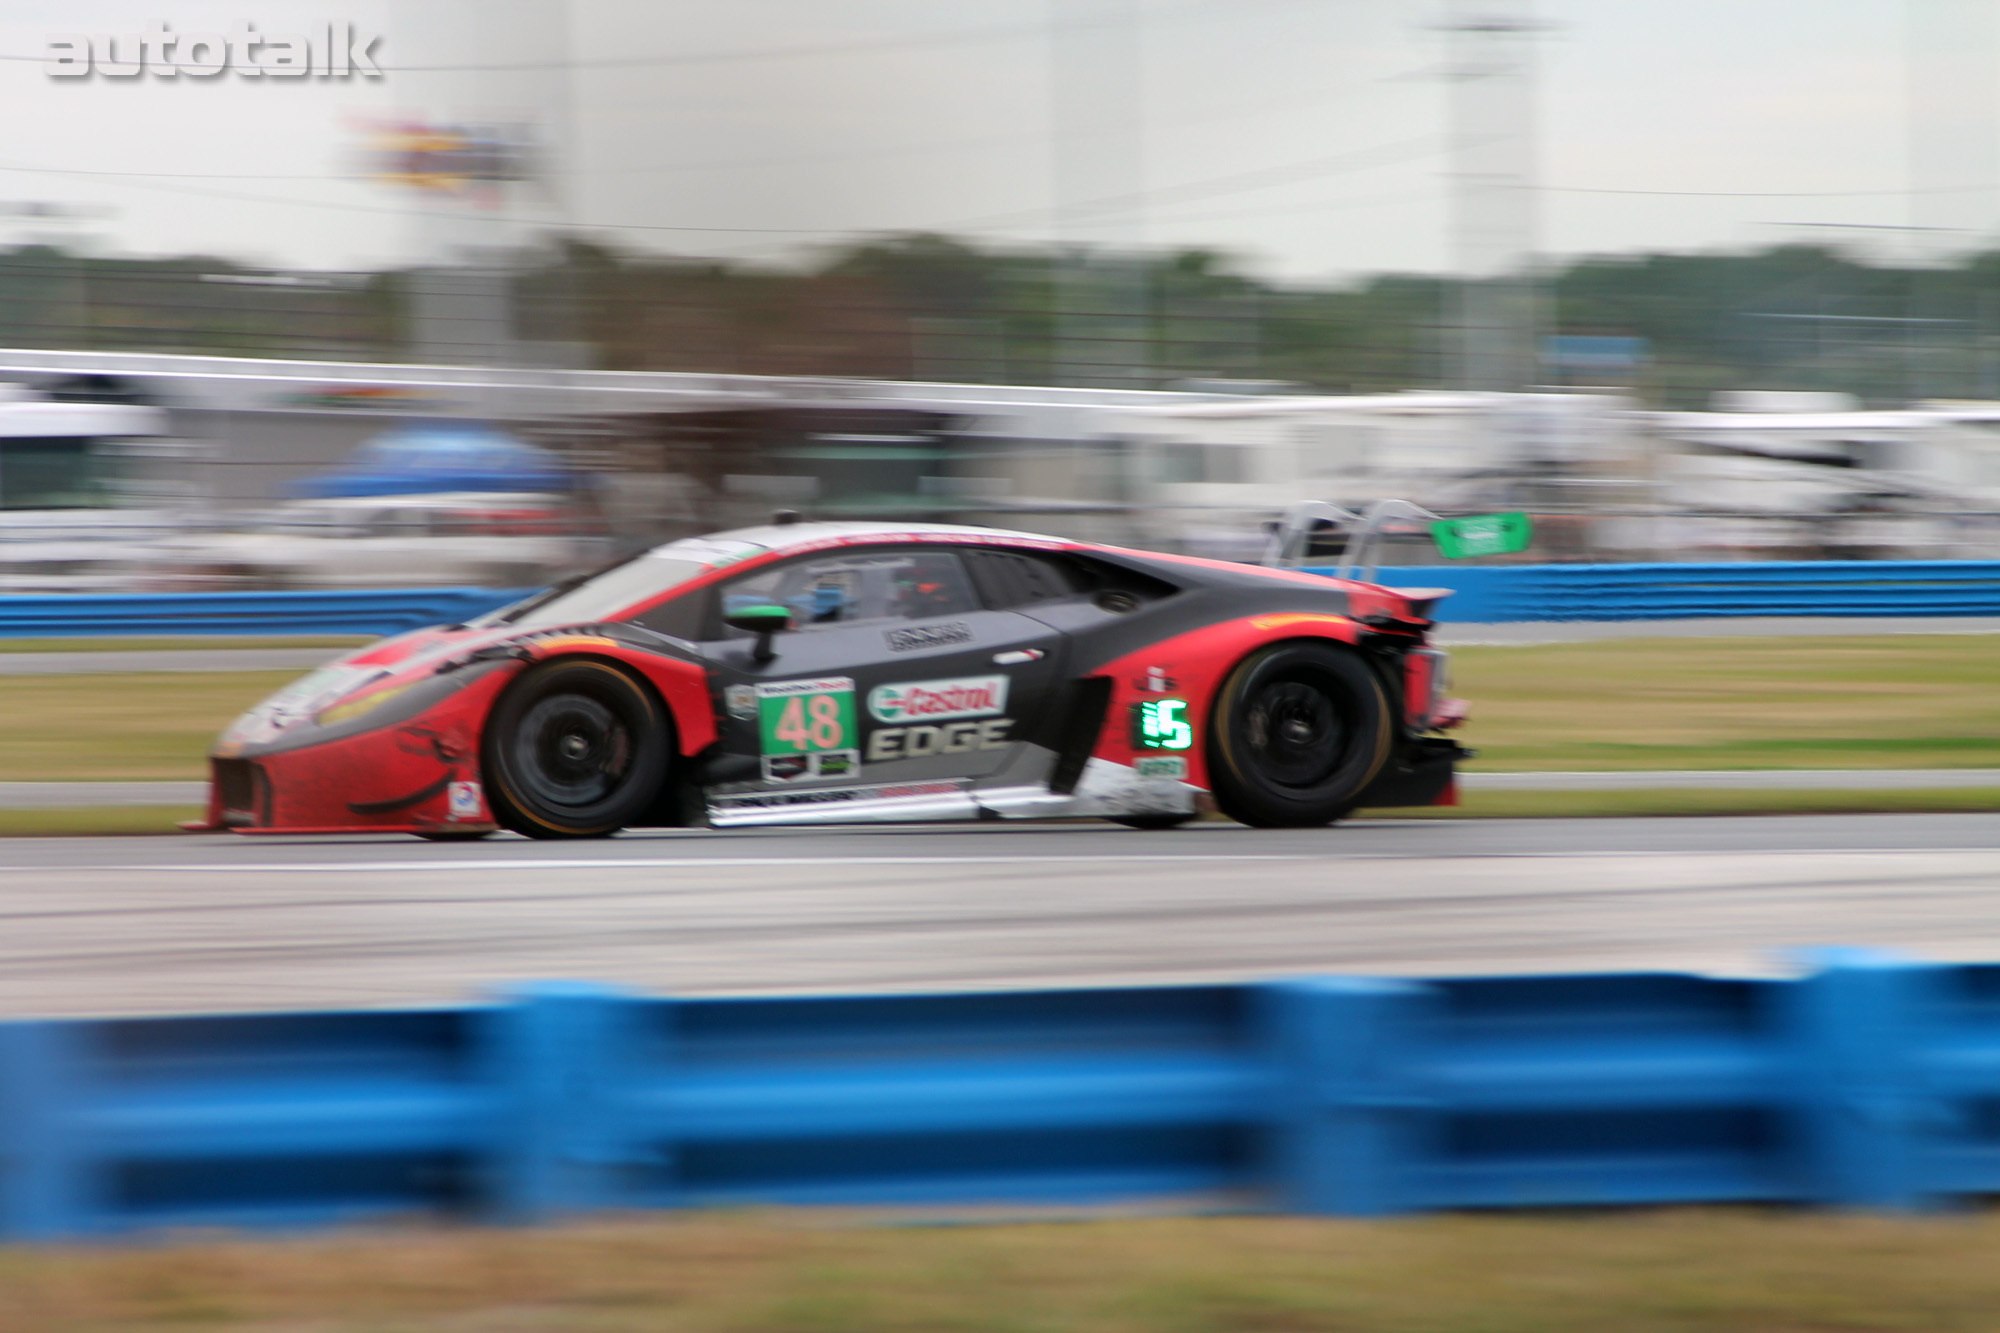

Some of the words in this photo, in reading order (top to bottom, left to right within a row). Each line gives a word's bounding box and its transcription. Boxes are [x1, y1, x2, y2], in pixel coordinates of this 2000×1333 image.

[903, 681, 999, 716] Castrol
[774, 694, 844, 751] 48
[866, 717, 1016, 761] EDGE
